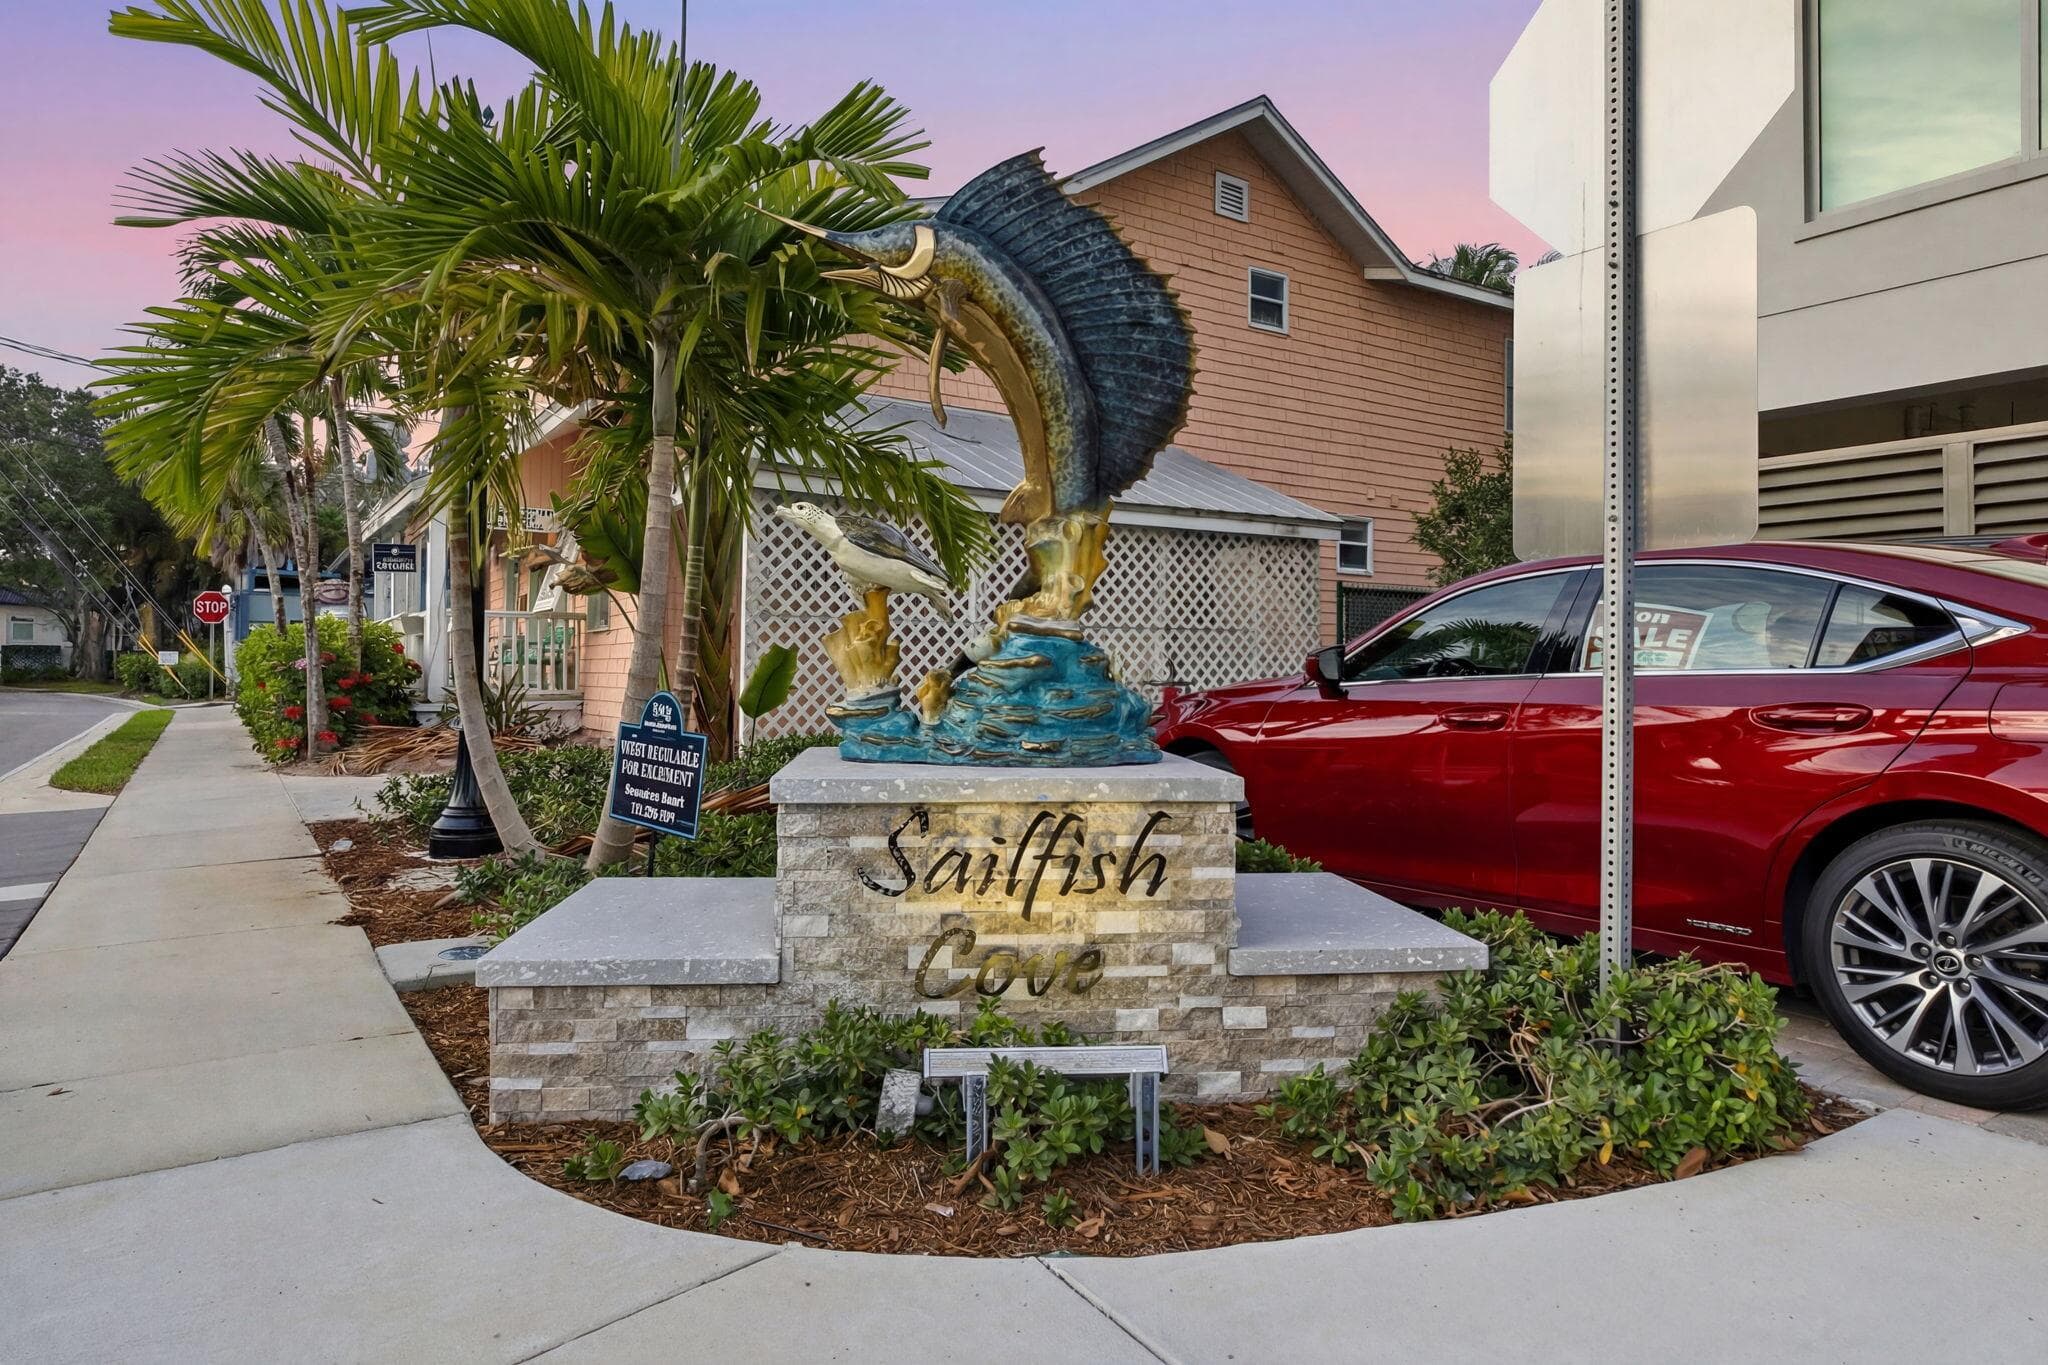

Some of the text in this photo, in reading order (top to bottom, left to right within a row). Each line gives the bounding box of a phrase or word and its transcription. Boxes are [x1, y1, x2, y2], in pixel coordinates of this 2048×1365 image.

[196, 600, 227, 614] STOP
[1634, 610, 1671, 624] OR
[857, 807, 1173, 922] Sailfish
[914, 927, 1105, 999] Cove
